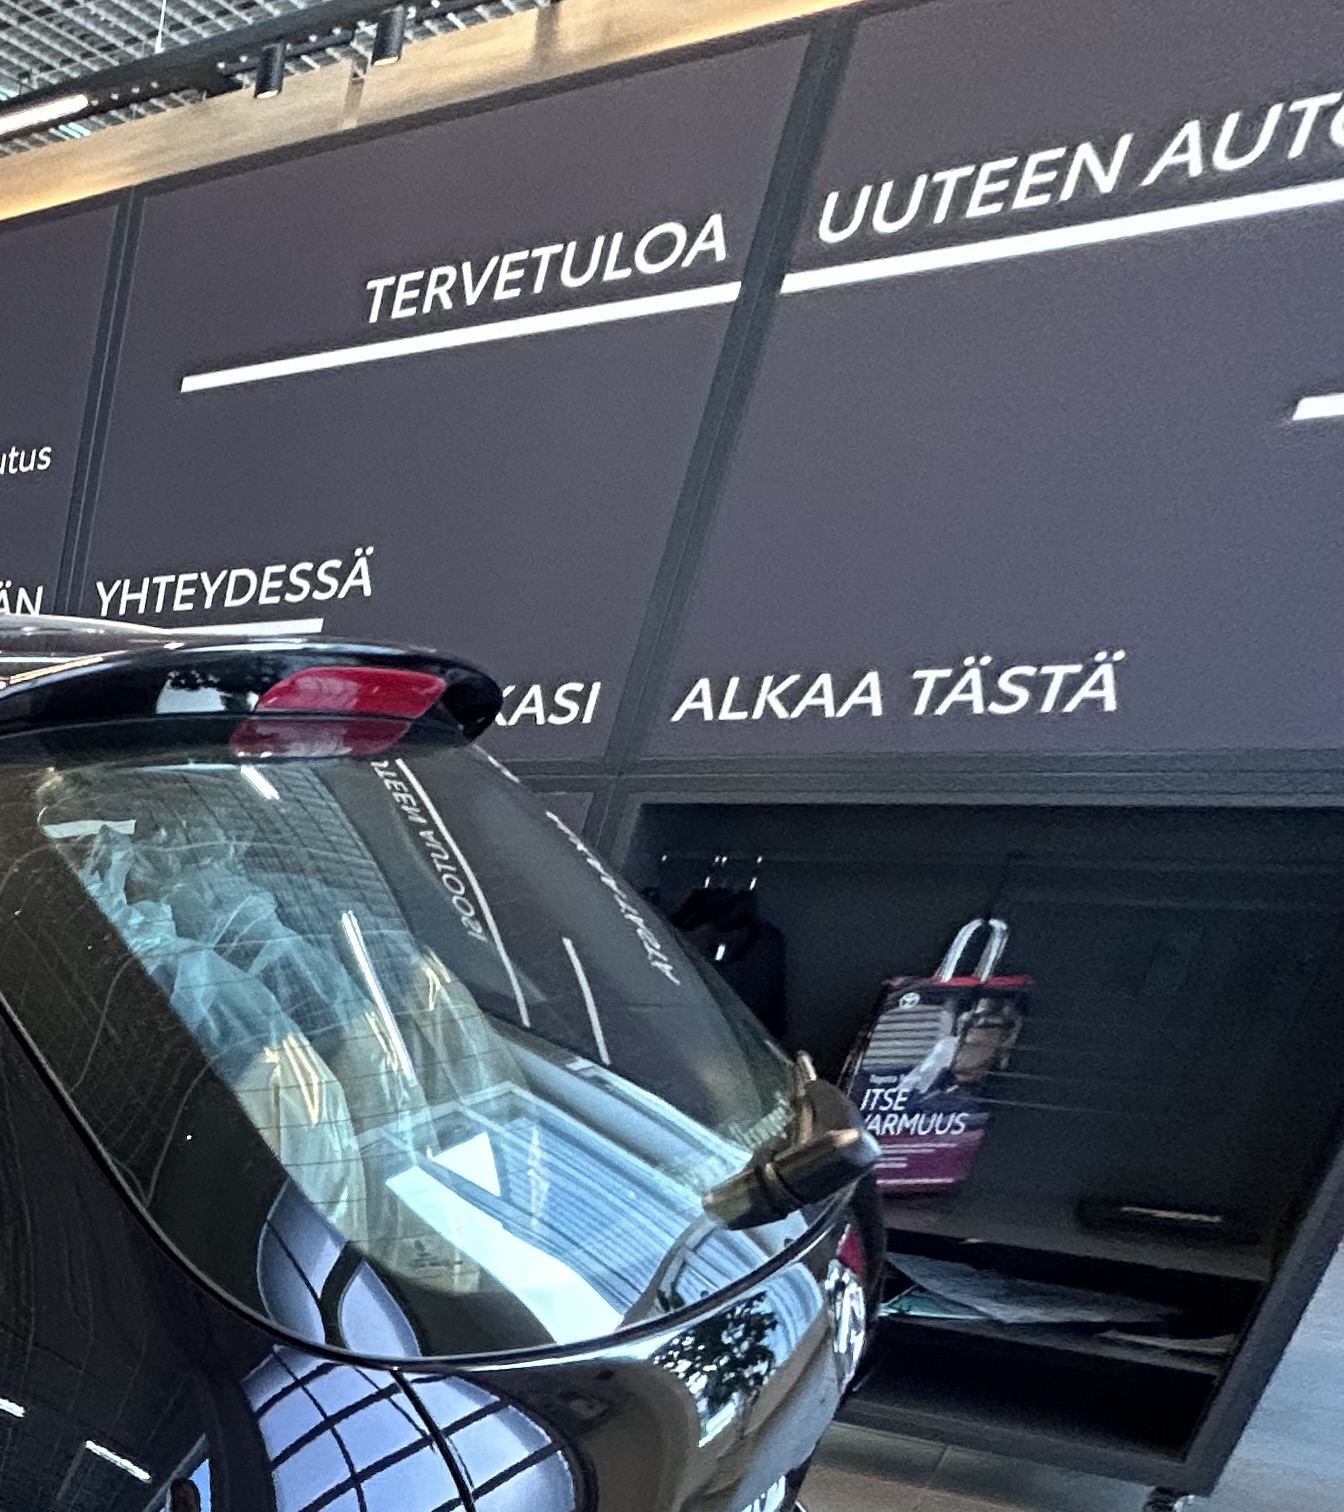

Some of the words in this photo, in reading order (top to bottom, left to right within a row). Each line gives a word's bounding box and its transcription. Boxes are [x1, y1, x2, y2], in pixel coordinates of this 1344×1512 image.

[365, 212, 727, 323] TERVETULOA
[817, 132, 1134, 244] UUTEEN
[1141, 91, 1344, 187] AUT
[95, 545, 375, 617] YHTEYDESSÄ
[670, 670, 885, 722] ALKAA
[912, 650, 1126, 716] TÄSTÄ
[859, 1087, 911, 1112] ITSE
